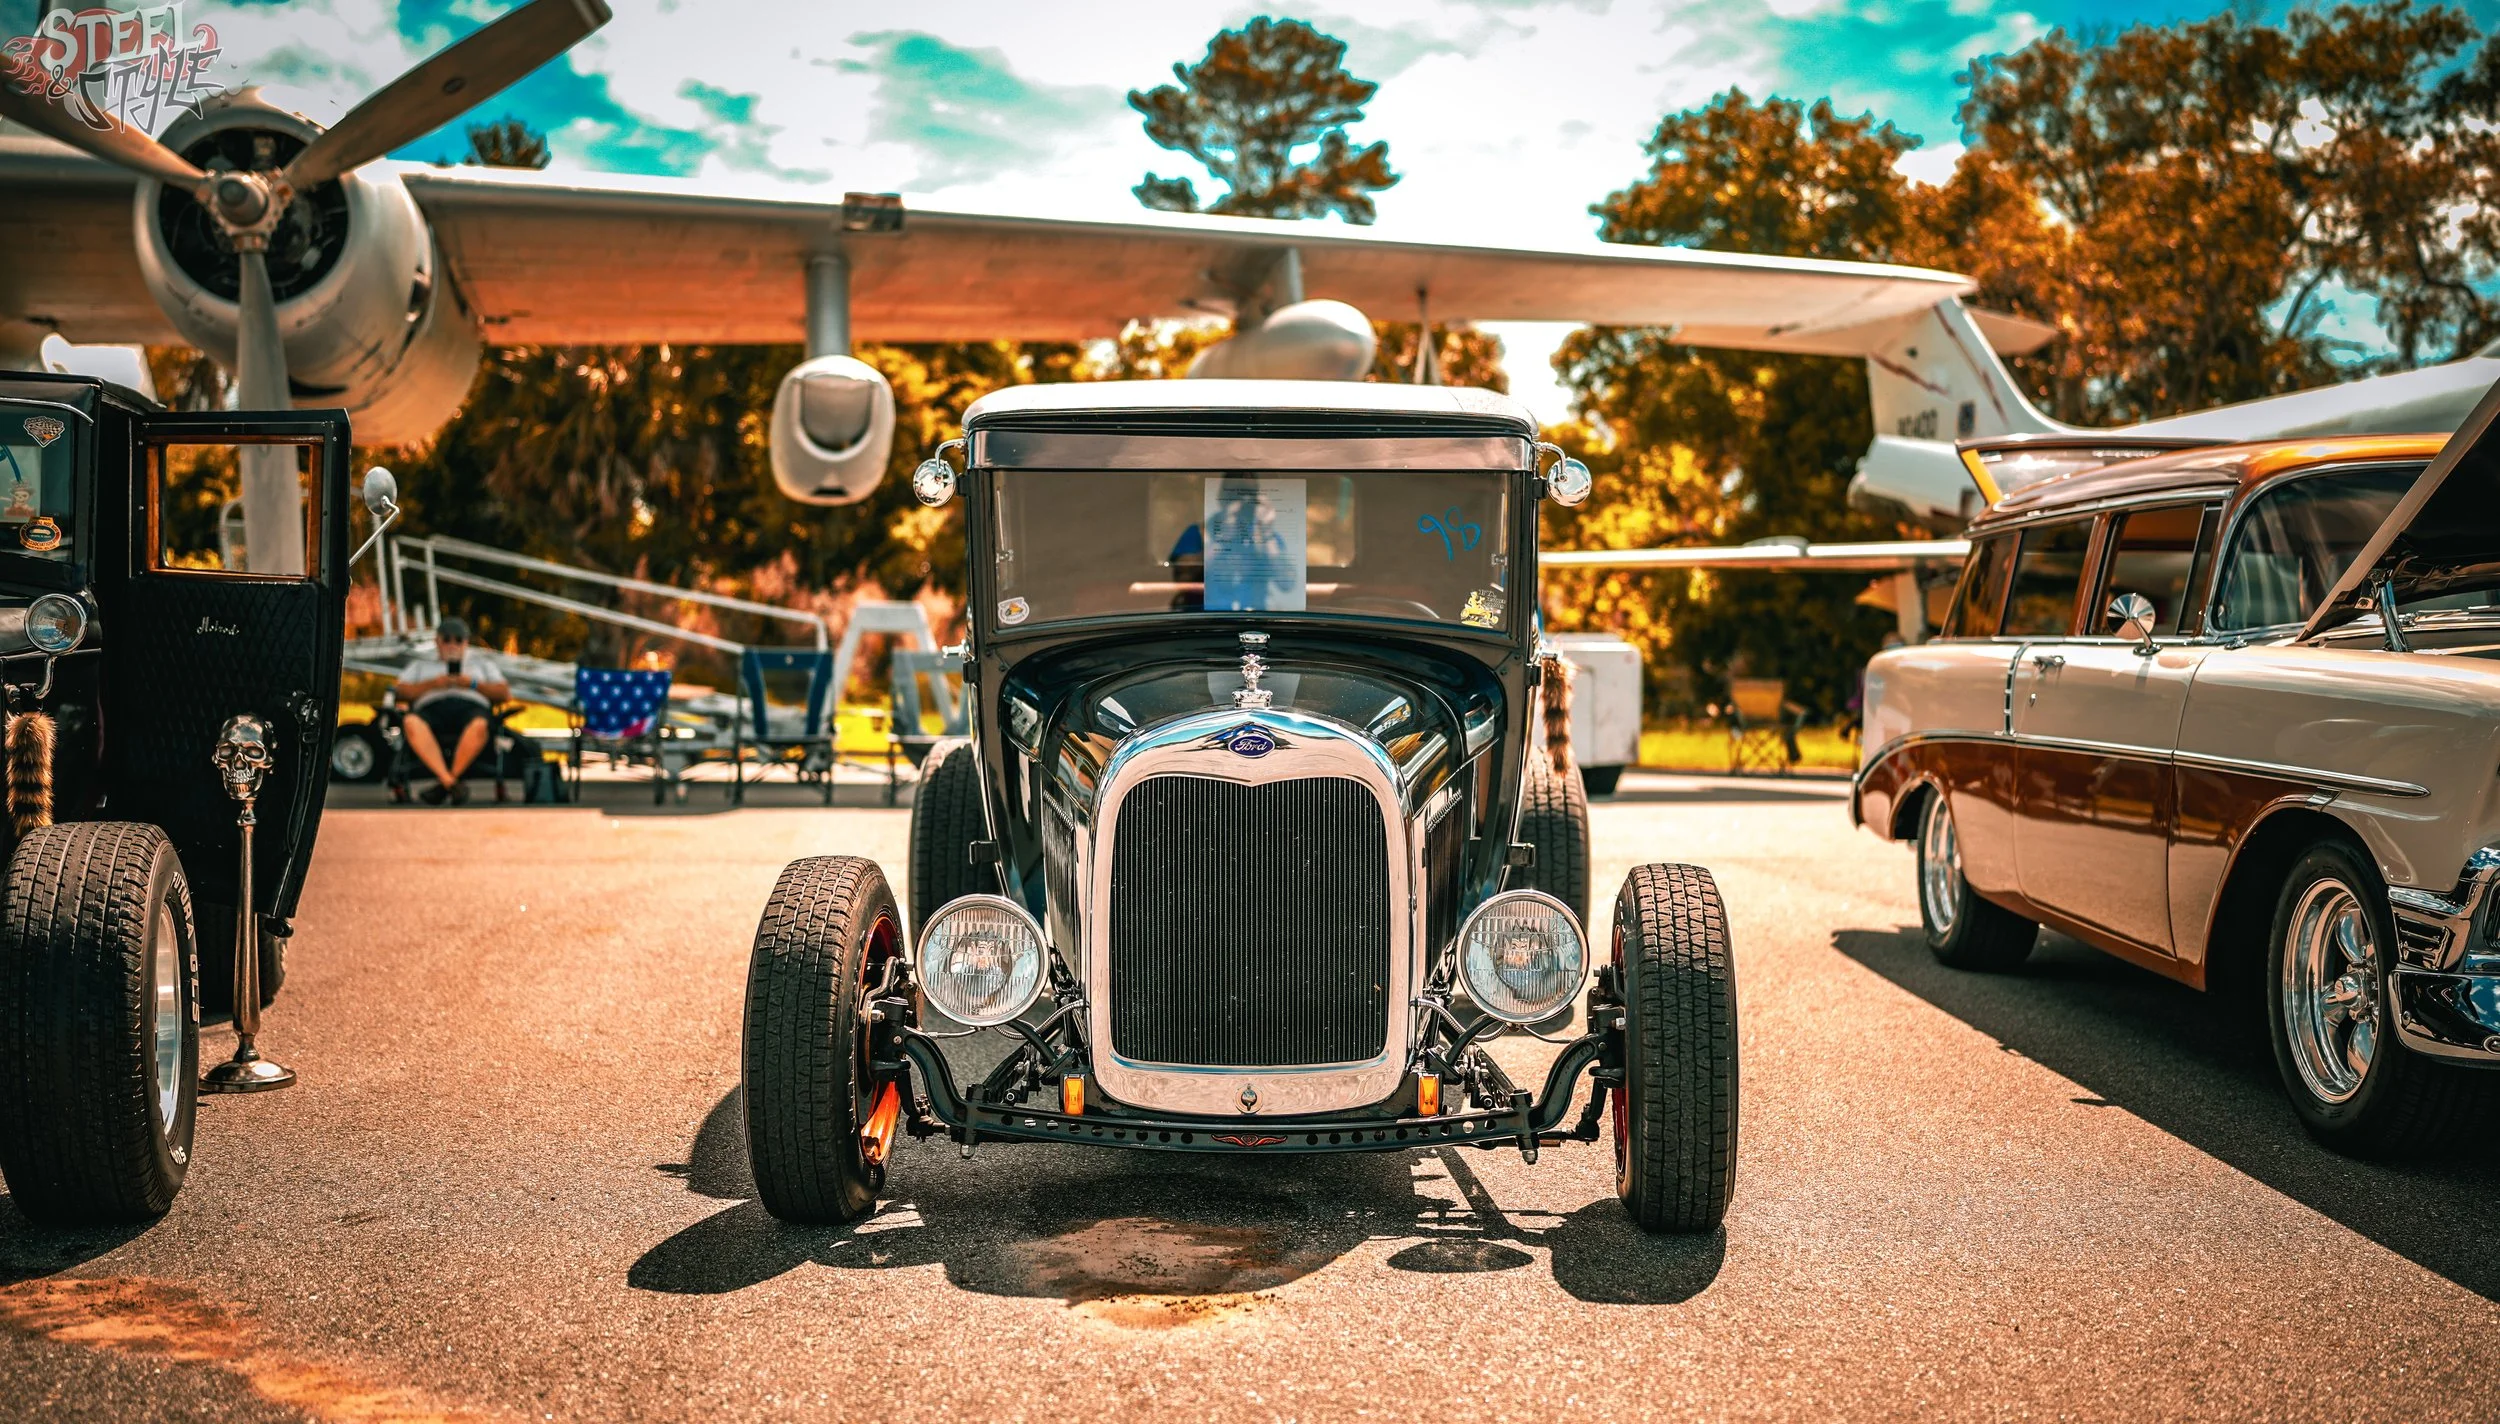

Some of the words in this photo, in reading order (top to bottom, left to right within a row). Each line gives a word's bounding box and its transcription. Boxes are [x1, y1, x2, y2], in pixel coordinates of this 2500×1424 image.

[1417, 505, 1482, 561] 98
[1234, 738, 1268, 751] Ford
[171, 871, 195, 940] FUTURA
